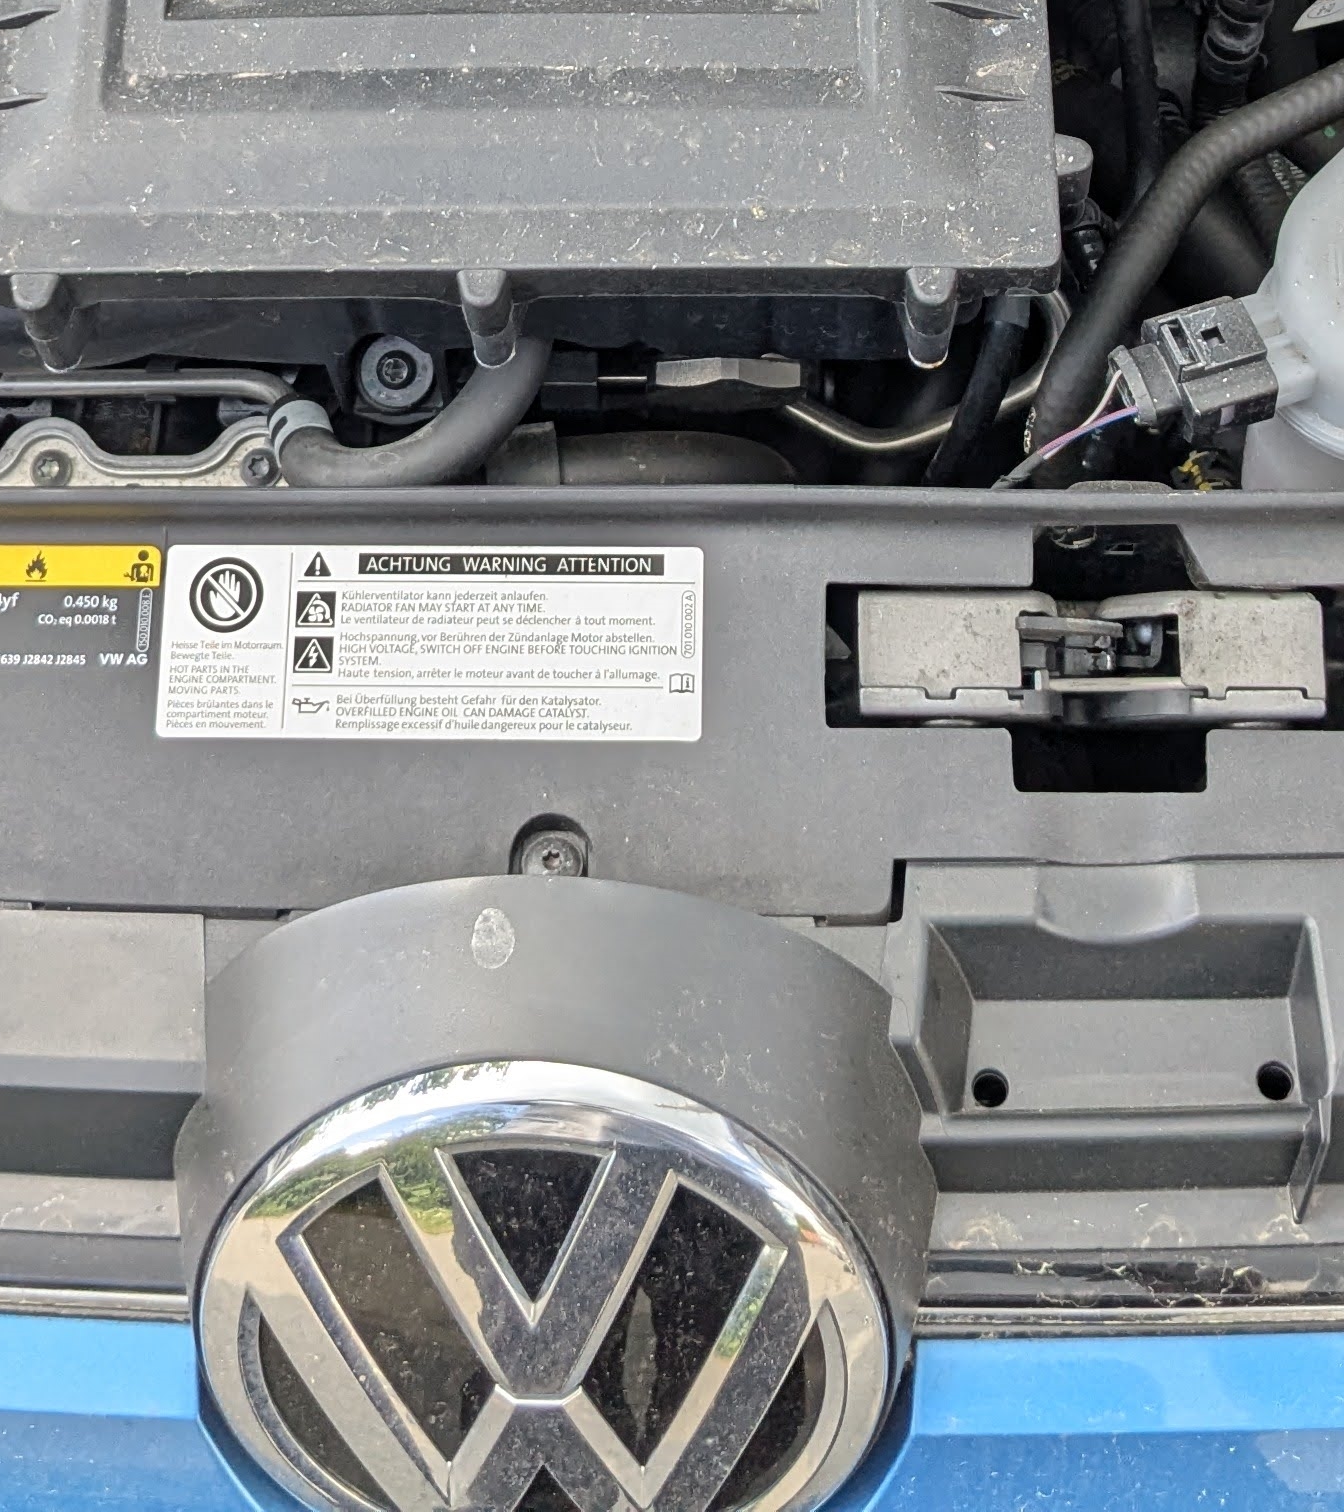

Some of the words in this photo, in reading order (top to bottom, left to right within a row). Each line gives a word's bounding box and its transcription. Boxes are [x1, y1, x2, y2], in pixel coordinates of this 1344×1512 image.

[366, 557, 450, 572] ACHTUNG
[462, 557, 546, 572] WARNING
[556, 558, 651, 572] ATTENTION
[342, 590, 424, 600] Kühlerventilator
[426, 590, 451, 600] kann
[453, 590, 497, 602] jederzeit
[500, 591, 548, 600] anlaufen.
[64, 596, 100, 608] 0.450
[102, 595, 118, 610] kg
[341, 602, 392, 612] RADIATOR
[395, 603, 415, 612] FAN
[418, 602, 442, 611] MAY
[444, 603, 475, 612] START
[477, 603, 490, 612] AT
[492, 603, 514, 612] ANY
[516, 603, 545, 612] TIME.
[684, 604, 693, 620] 002
[59, 616, 72, 626] eq
[74, 614, 108, 624] 0.0018
[111, 614, 116, 624] t
[340, 614, 351, 623] Le
[354, 615, 409, 624] ventilateur
[412, 615, 424, 624] de
[427, 615, 474, 624] radiateur
[476, 615, 499, 627] peut
[515, 615, 571, 625] déclencher
[584, 616, 605, 625] tout
[608, 616, 655, 625] moment.
[684, 623, 692, 638] 010
[340, 632, 419, 644] Hochspannung,
[440, 632, 486, 642] Berühren
[488, 632, 505, 642] der
[508, 633, 568, 644] Zündanlage
[570, 633, 603, 642] Motor
[605, 633, 654, 642] abstellen.
[200, 640, 219, 649] Teile
[234, 641, 283, 649] Motorraum.
[339, 644, 366, 653] HIGH
[369, 644, 417, 654] VOLTAGE,
[420, 644, 460, 653] SWITCH
[463, 644, 482, 654] OFF
[485, 644, 524, 654] ENGINE
[528, 644, 565, 654] BEFORE
[569, 645, 625, 654] TOUCHING
[628, 645, 676, 655] IGNITION
[684, 640, 692, 655] 701
[23, 654, 53, 664] J2842
[55, 654, 86, 664] J2845
[99, 653, 125, 664] VW
[127, 653, 148, 664] AG
[170, 651, 209, 662] Bewegte
[211, 651, 234, 659] Teile.
[338, 656, 381, 665] SYSTEM.
[169, 664, 188, 673] HOT
[191, 665, 217, 673] PARTS
[232, 665, 249, 673] THE
[338, 668, 369, 677] Haute
[373, 668, 414, 679] tension,
[454, 669, 462, 678] le
[466, 669, 503, 678] moteur
[506, 669, 534, 678] avant
[537, 669, 550, 678] de
[552, 669, 592, 678] toucher
[169, 674, 202, 683] ENGINE
[206, 675, 276, 683] COMPARTMENT.
[168, 686, 207, 694] MOVING
[210, 686, 240, 694] PARTS.
[241, 699, 263, 708] dans
[265, 700, 273, 708] le
[336, 694, 352, 704] Bei
[354, 694, 416, 707] Überfüllung
[419, 694, 458, 704] besteht
[461, 694, 496, 704] Gefahr
[501, 694, 516, 705] für
[518, 695, 538, 705] den
[541, 695, 601, 707] Katalysator.
[166, 710, 230, 720] compartiment
[336, 706, 396, 716] OVERFILLED
[399, 707, 438, 716] ENGINE
[441, 707, 457, 717] OIL
[463, 707, 485, 717] CAN
[488, 707, 535, 717] DAMAGE
[538, 707, 589, 718] CATALYST.
[335, 719, 399, 731] Remplissage
[401, 719, 443, 729] excessif
[480, 719, 536, 732] dangereux
[538, 722, 563, 732] pour
[565, 720, 574, 730] le
[576, 720, 632, 733] catalyseur.
[201, 1061, 894, 1512] VW
